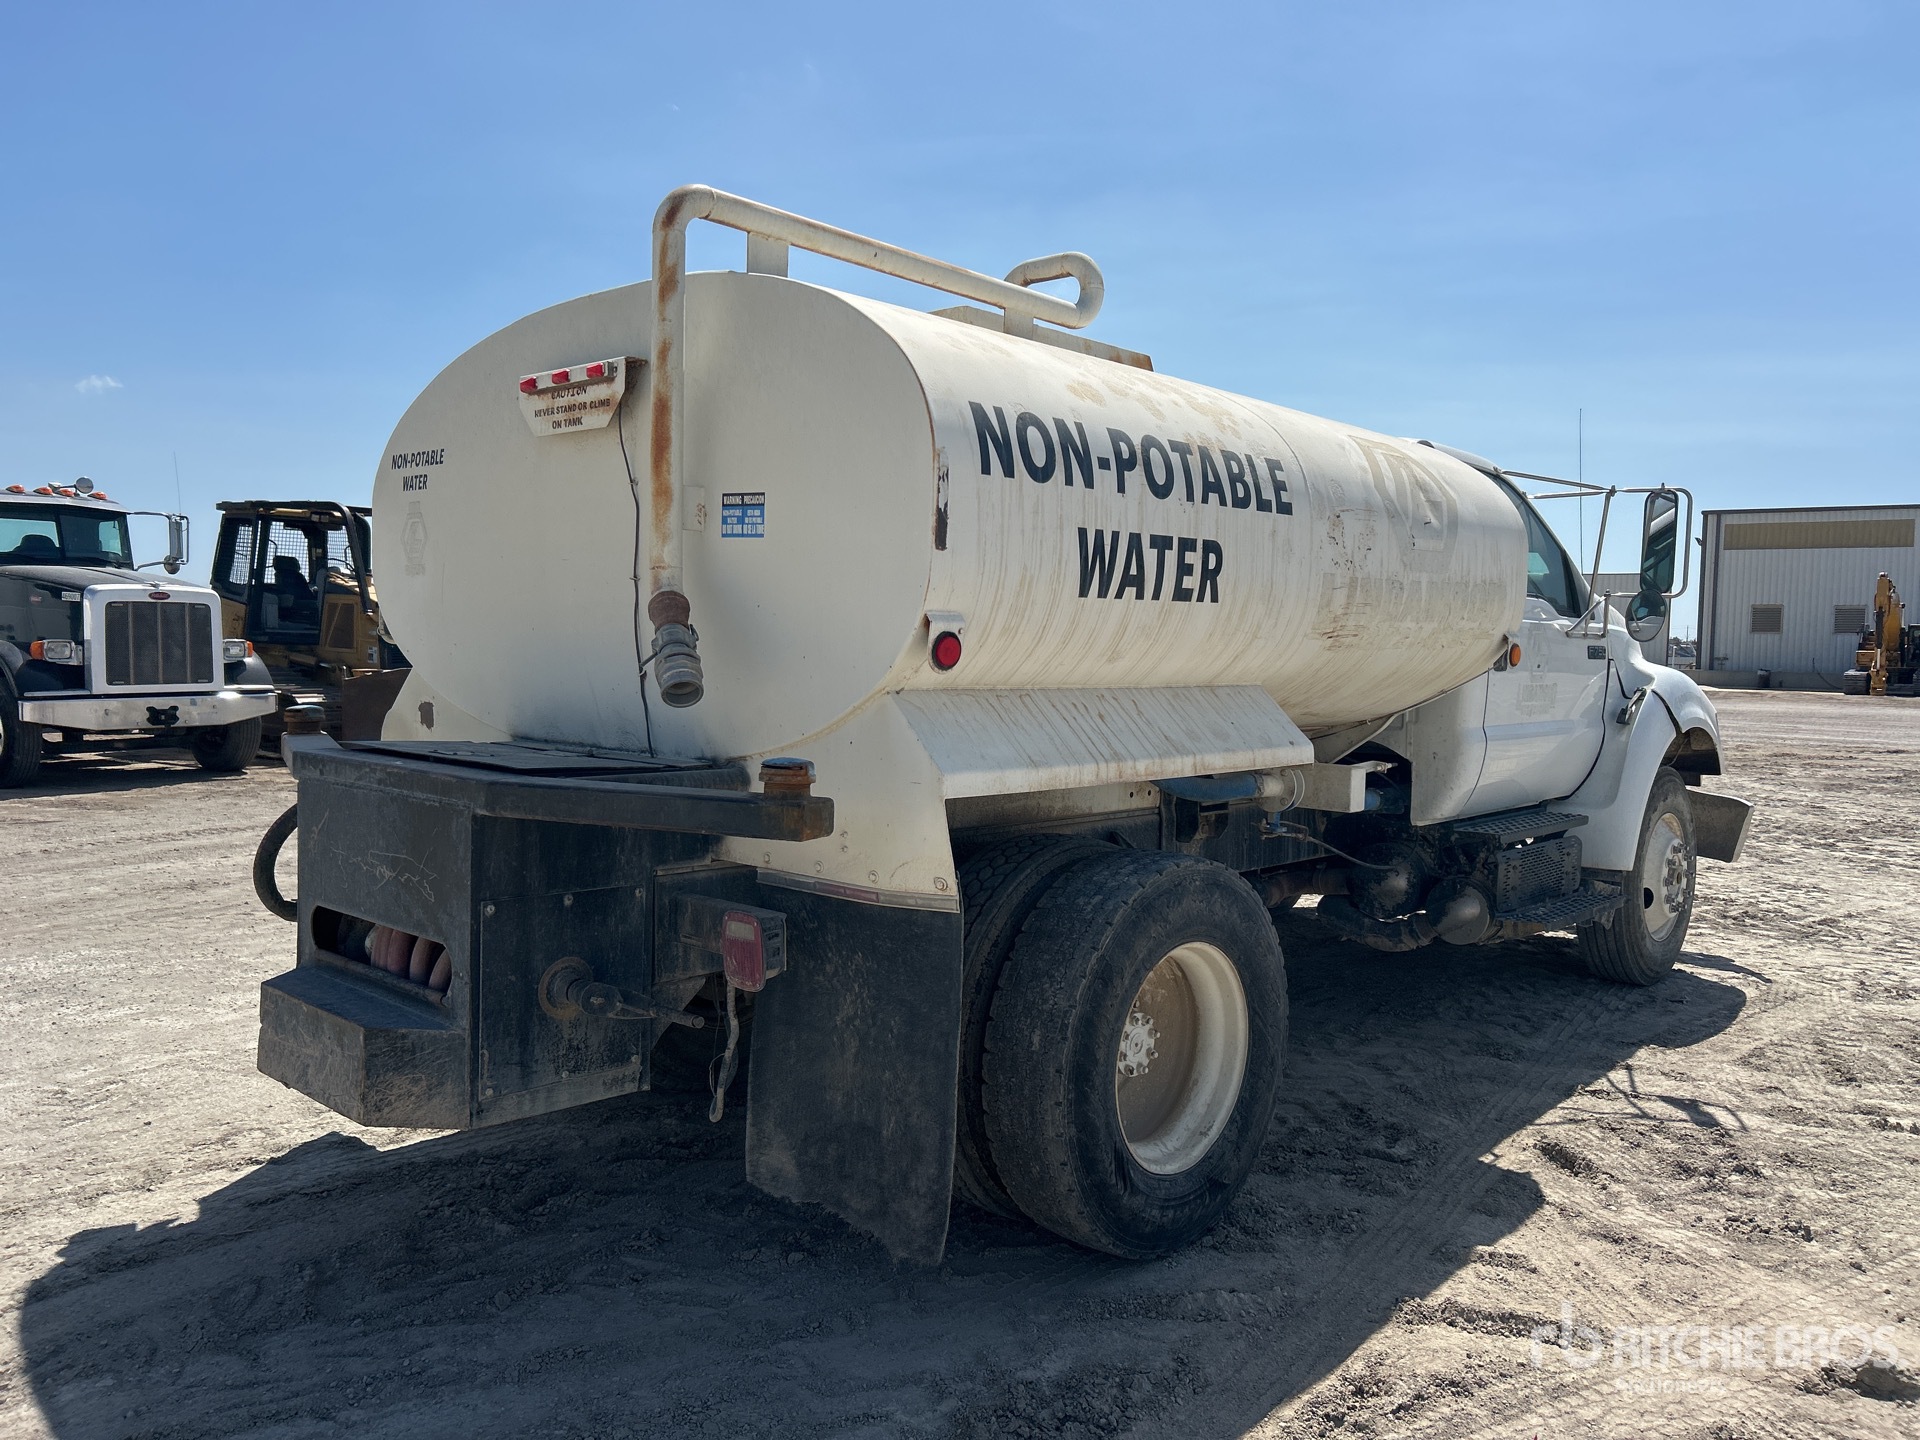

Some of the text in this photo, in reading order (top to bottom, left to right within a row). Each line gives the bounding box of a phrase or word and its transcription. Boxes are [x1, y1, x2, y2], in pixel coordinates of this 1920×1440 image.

[551, 385, 588, 400] CAUTION
[534, 398, 611, 418] NEVER STAND OR CLIMB
[551, 416, 583, 430] ON TANK
[391, 448, 445, 470] NON-POTABLE
[968, 400, 1293, 516] NON-POTABLE
[402, 473, 428, 492] WATER
[1077, 527, 1224, 603] WATER
